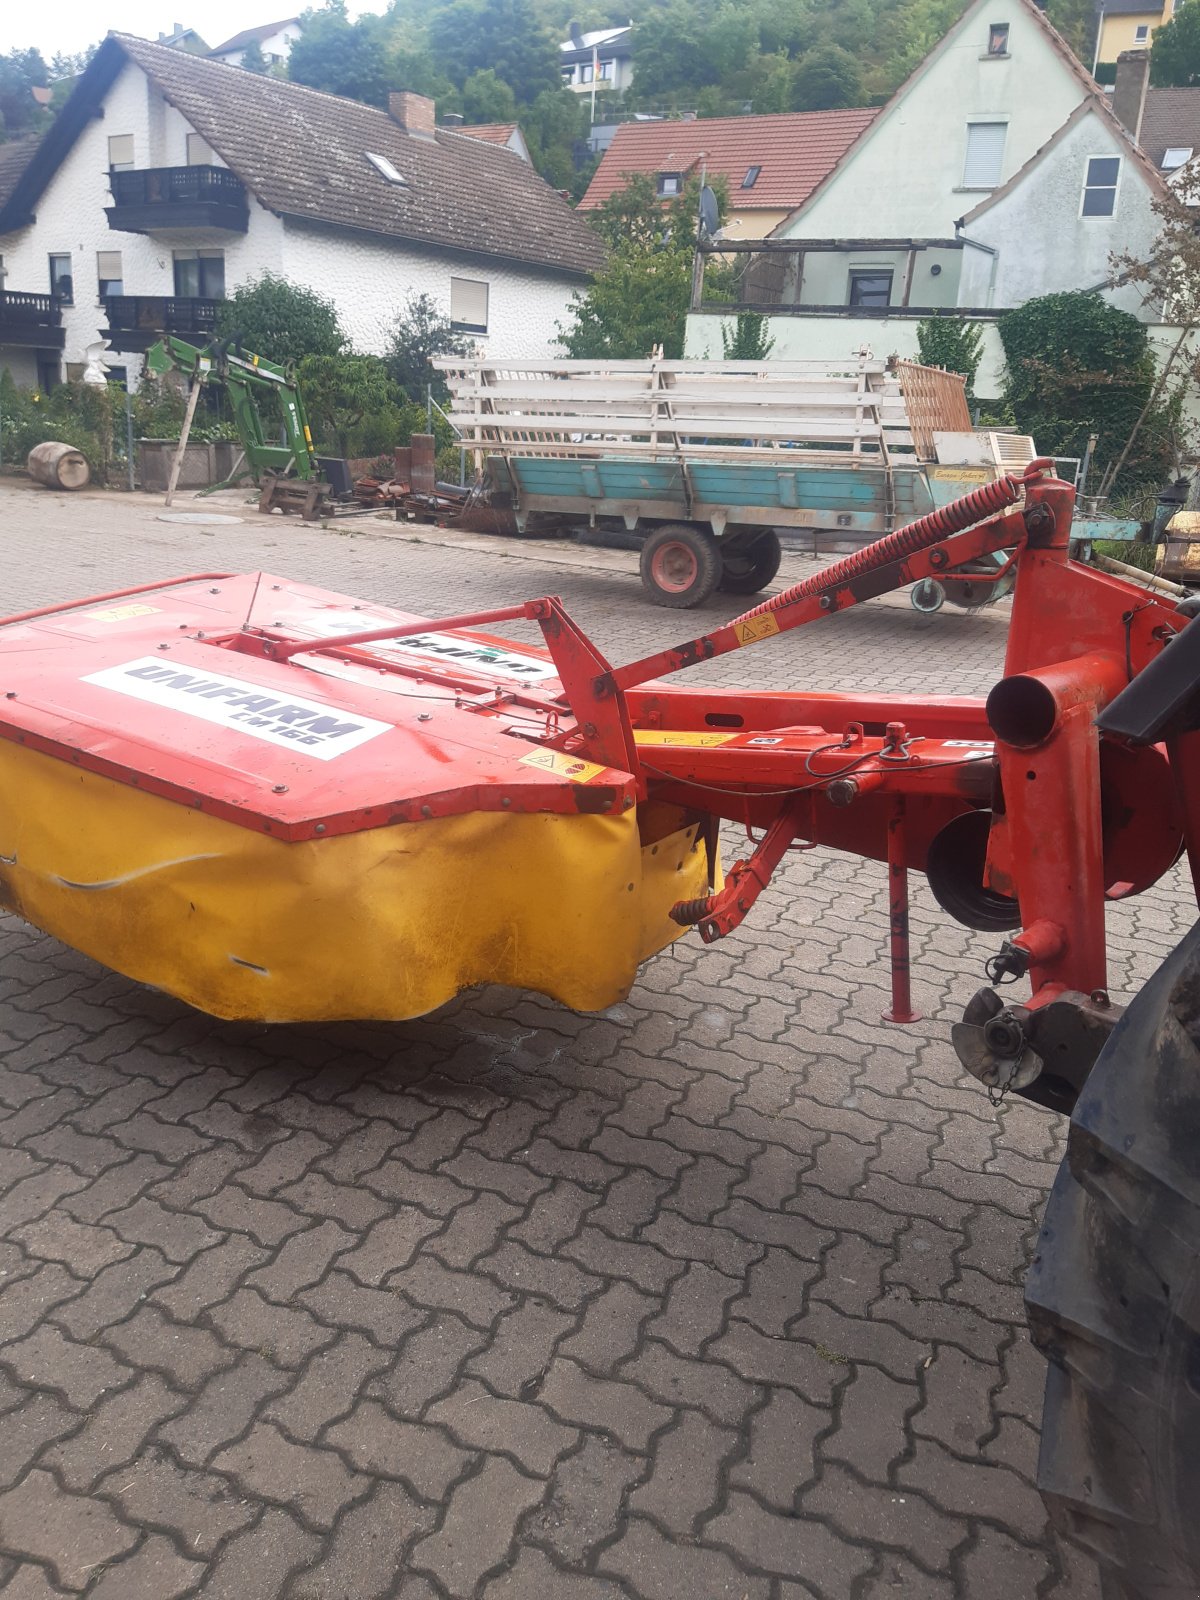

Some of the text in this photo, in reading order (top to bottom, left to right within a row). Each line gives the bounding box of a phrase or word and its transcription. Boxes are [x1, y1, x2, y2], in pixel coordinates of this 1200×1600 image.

[124, 665, 365, 739] UNIFARM
[228, 712, 326, 745] CM 166
